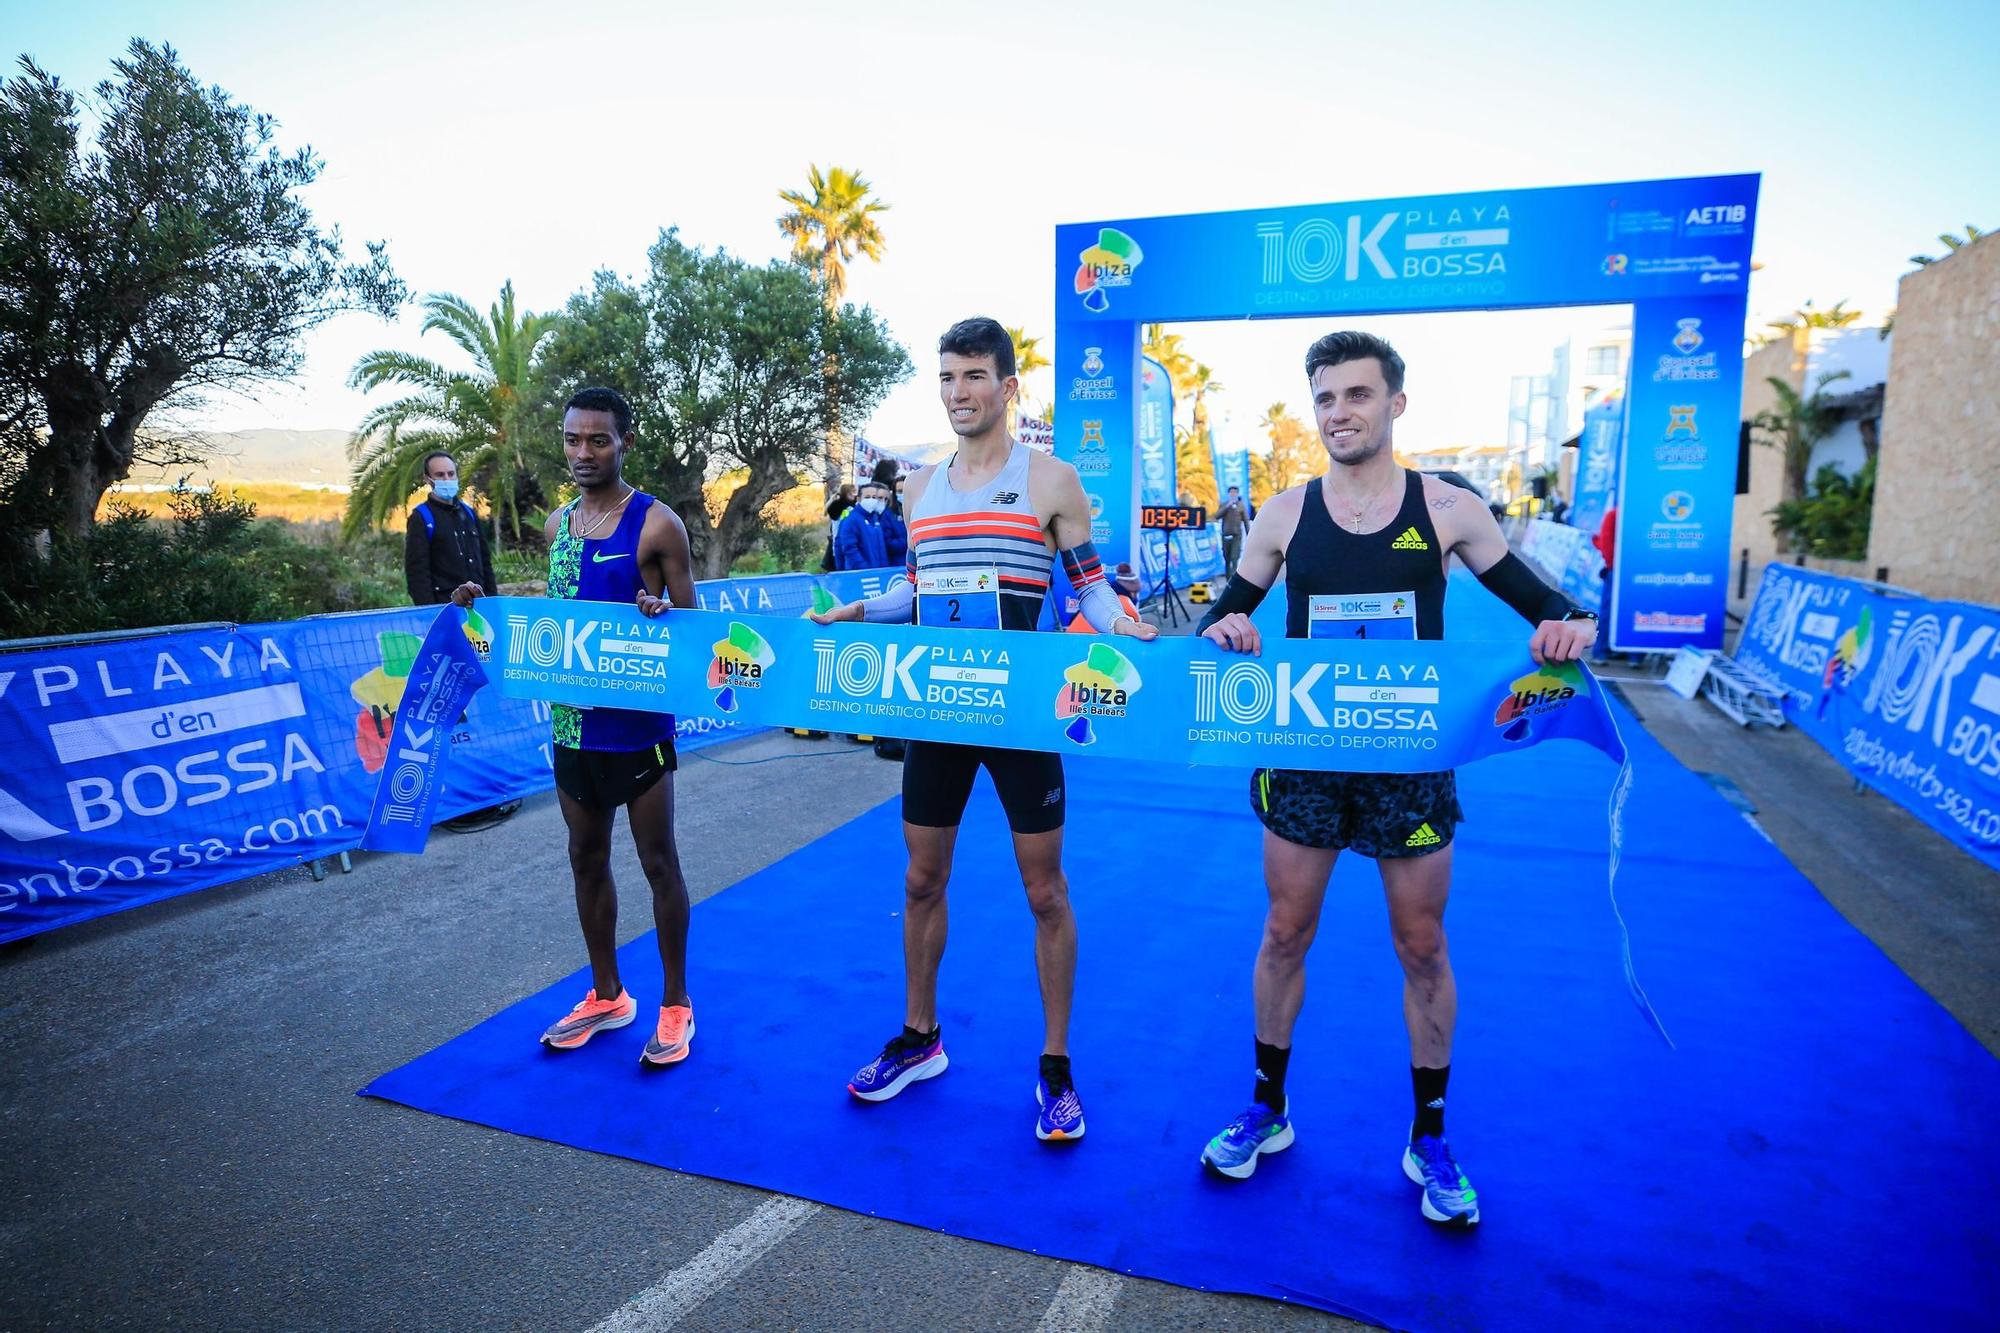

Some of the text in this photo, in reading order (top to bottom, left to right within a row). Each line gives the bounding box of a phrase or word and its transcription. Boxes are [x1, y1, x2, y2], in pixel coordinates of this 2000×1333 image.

[1406, 205, 1510, 226] PLAYA
[1685, 205, 1746, 224] AETIB
[1257, 212, 1400, 284] 10K
[1087, 261, 1131, 278] Ibiza
[1403, 252, 1507, 278] BOSSA
[1073, 377, 1113, 388] Consell
[1392, 540, 1428, 550] adidas
[935, 577, 955, 589] 10K
[948, 598, 961, 622] 2
[1340, 601, 1364, 613] 10K
[601, 621, 672, 640] PLAYA
[1355, 624, 1366, 639] 1
[507, 614, 599, 673] 10K
[624, 642, 643, 653] d'en
[718, 656, 762, 678] Ibiza
[931, 647, 1010, 665] PLAYA
[33, 638, 291, 707] PLAYA
[599, 656, 667, 679] BOSSA
[813, 638, 929, 702] 10K
[957, 670, 977, 680] d'en
[1335, 664, 1439, 681] PLAYA
[407, 652, 443, 719] PLAYA
[504, 668, 666, 694] DESTINO TURÍSTICO DEPORTIVO
[719, 676, 760, 688] Illes Balears
[1864, 610, 1997, 748] 10K
[426, 661, 466, 723] BOSSA
[927, 685, 1006, 708] BOSSA
[1070, 682, 1127, 705] Ibiza
[1189, 660, 1331, 728] 10K
[1370, 689, 1396, 701] d'en
[1512, 687, 1576, 709] Ibiza
[810, 699, 1004, 726] DESTINO TURÍSTICO DEPORTIVO
[1069, 705, 1125, 717] Illes Balears
[1334, 708, 1438, 731] BOSSA
[150, 707, 217, 740] d'en
[1188, 728, 1437, 750] DESTINO TURÍSTICO DEPORTIVO
[66, 732, 325, 832] BOSSA
[380, 720, 434, 825] 10K
[414, 781, 433, 828] DESTINO
[1406, 835, 1440, 847] adidas
